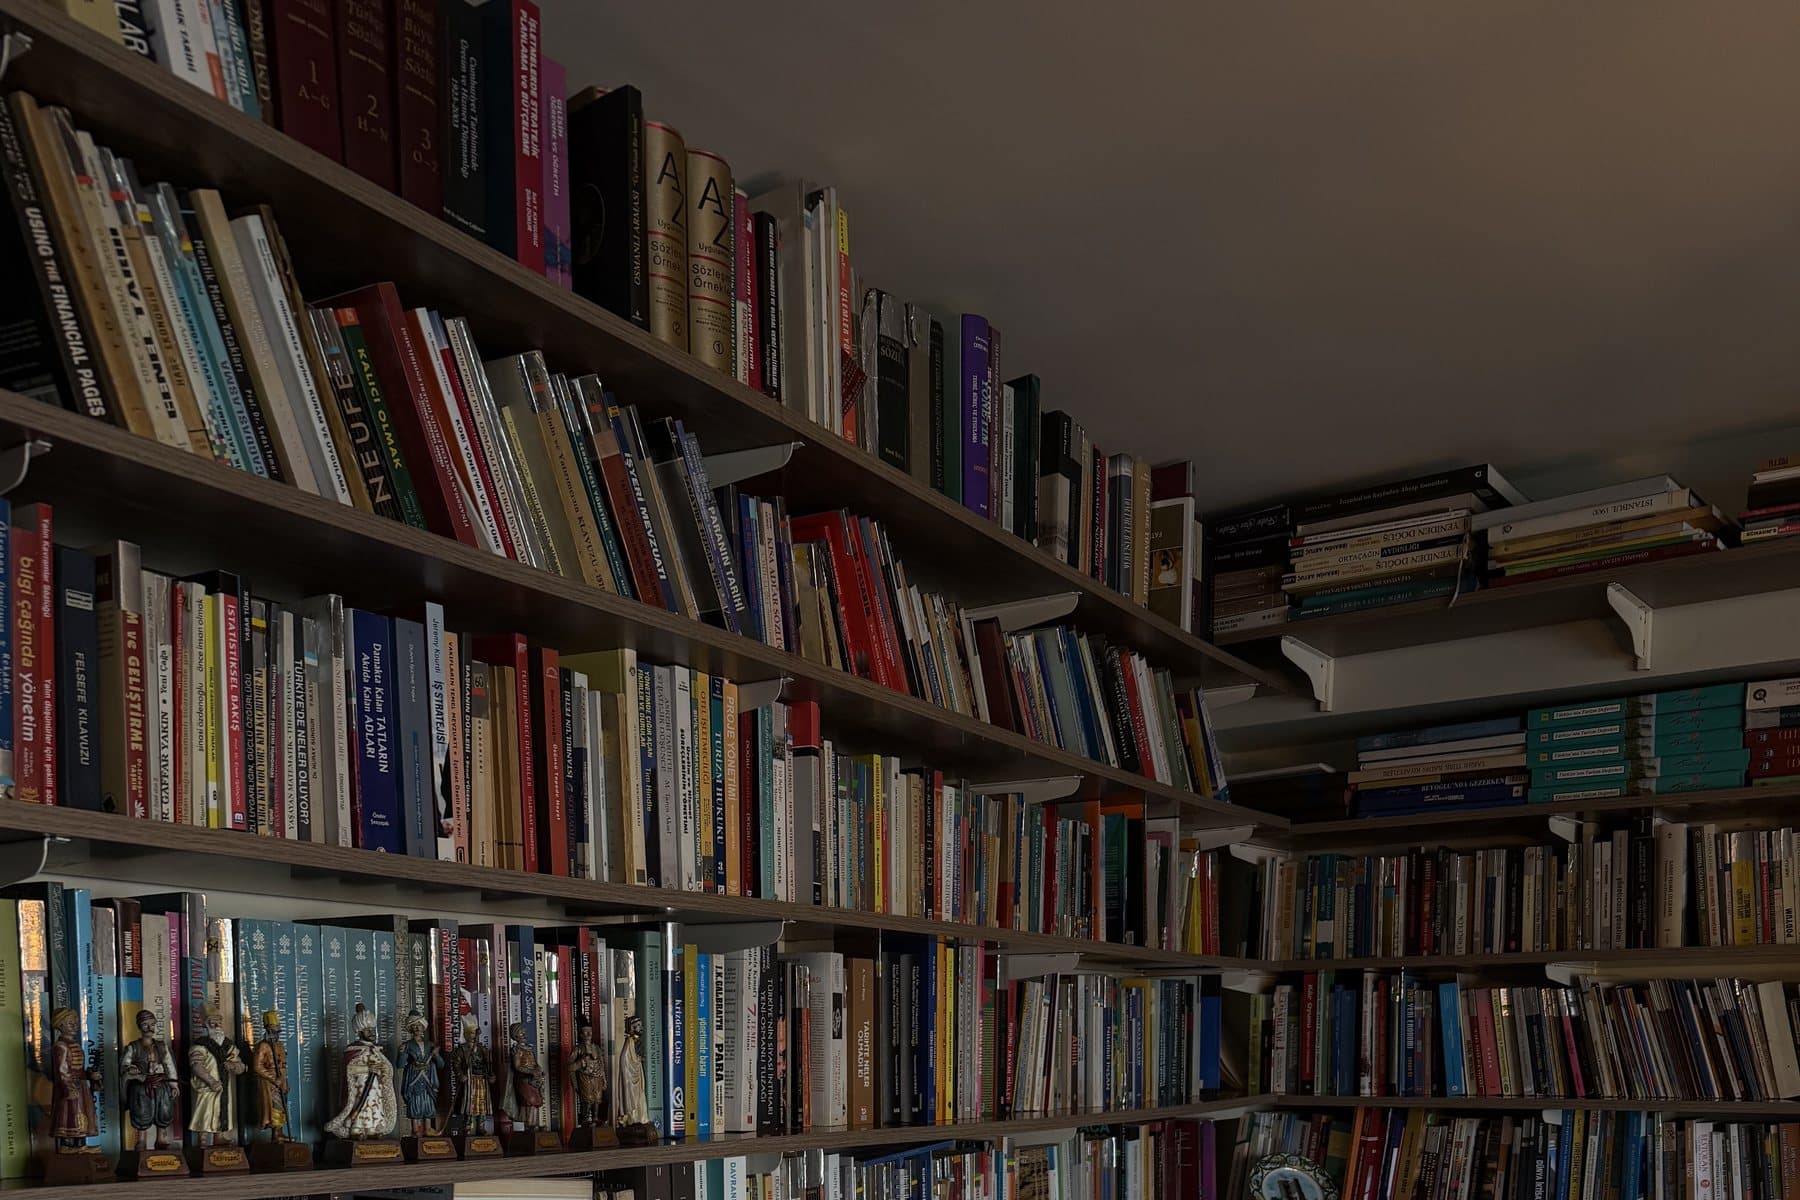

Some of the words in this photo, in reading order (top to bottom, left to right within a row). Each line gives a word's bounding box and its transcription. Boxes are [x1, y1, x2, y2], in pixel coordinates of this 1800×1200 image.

[25, 206, 55, 257] USING
[49, 285, 88, 366] FINANCIAL
[75, 369, 107, 418] PAGES
[356, 347, 383, 404] KALICI
[373, 409, 403, 471] OLMAK
[623, 453, 645, 502] İŞYERİ
[640, 506, 667, 580] MEVZUATI
[19, 556, 35, 595] bilgi
[707, 506, 730, 567] PARANIN
[724, 568, 745, 612] TARİHİ
[18, 599, 36, 667] çağında
[126, 631, 137, 650] ve
[226, 603, 239, 691] İSTATİSTİKSEL
[75, 651, 88, 703] FELSEFE
[362, 652, 372, 683] Akılda
[373, 642, 383, 684] Damakta
[18, 672, 37, 742] yönetim
[125, 656, 143, 752] GELİŞTİRME
[229, 694, 241, 731] BAKIŞ
[363, 685, 373, 712] Kalan
[375, 687, 385, 713] Kalan
[435, 693, 447, 745] STRATEJİSİ
[727, 697, 736, 738] PROJE
[77, 708, 91, 767] KILAVUZU
[297, 729, 307, 768] NELER
[364, 715, 376, 759] ADLARI
[376, 716, 388, 773] TATLARIN
[715, 731, 724, 784] TURİZM
[299, 771, 310, 825] OLUYOR?
[727, 744, 738, 801] YÖNETİMİ
[715, 787, 725, 845] HUKUKU
[674, 999, 684, 1036] Krizden
[715, 1042, 724, 1083] PARA
